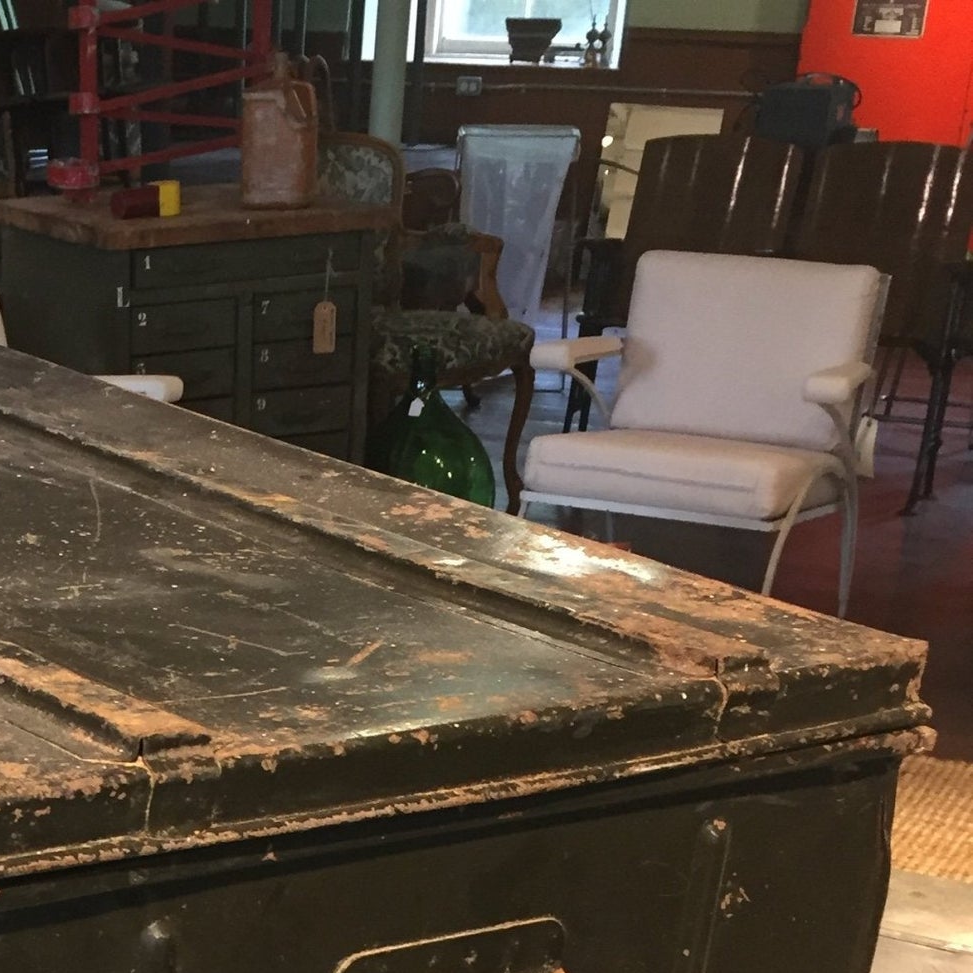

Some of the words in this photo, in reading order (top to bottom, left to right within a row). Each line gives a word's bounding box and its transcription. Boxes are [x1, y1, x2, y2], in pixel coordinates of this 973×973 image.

[144, 255, 151, 269] 1
[117, 286, 130, 307] L
[261, 299, 270, 314] 7
[138, 312, 147, 326] 2
[260, 349, 269, 363] 8
[256, 398, 266, 410] 9
